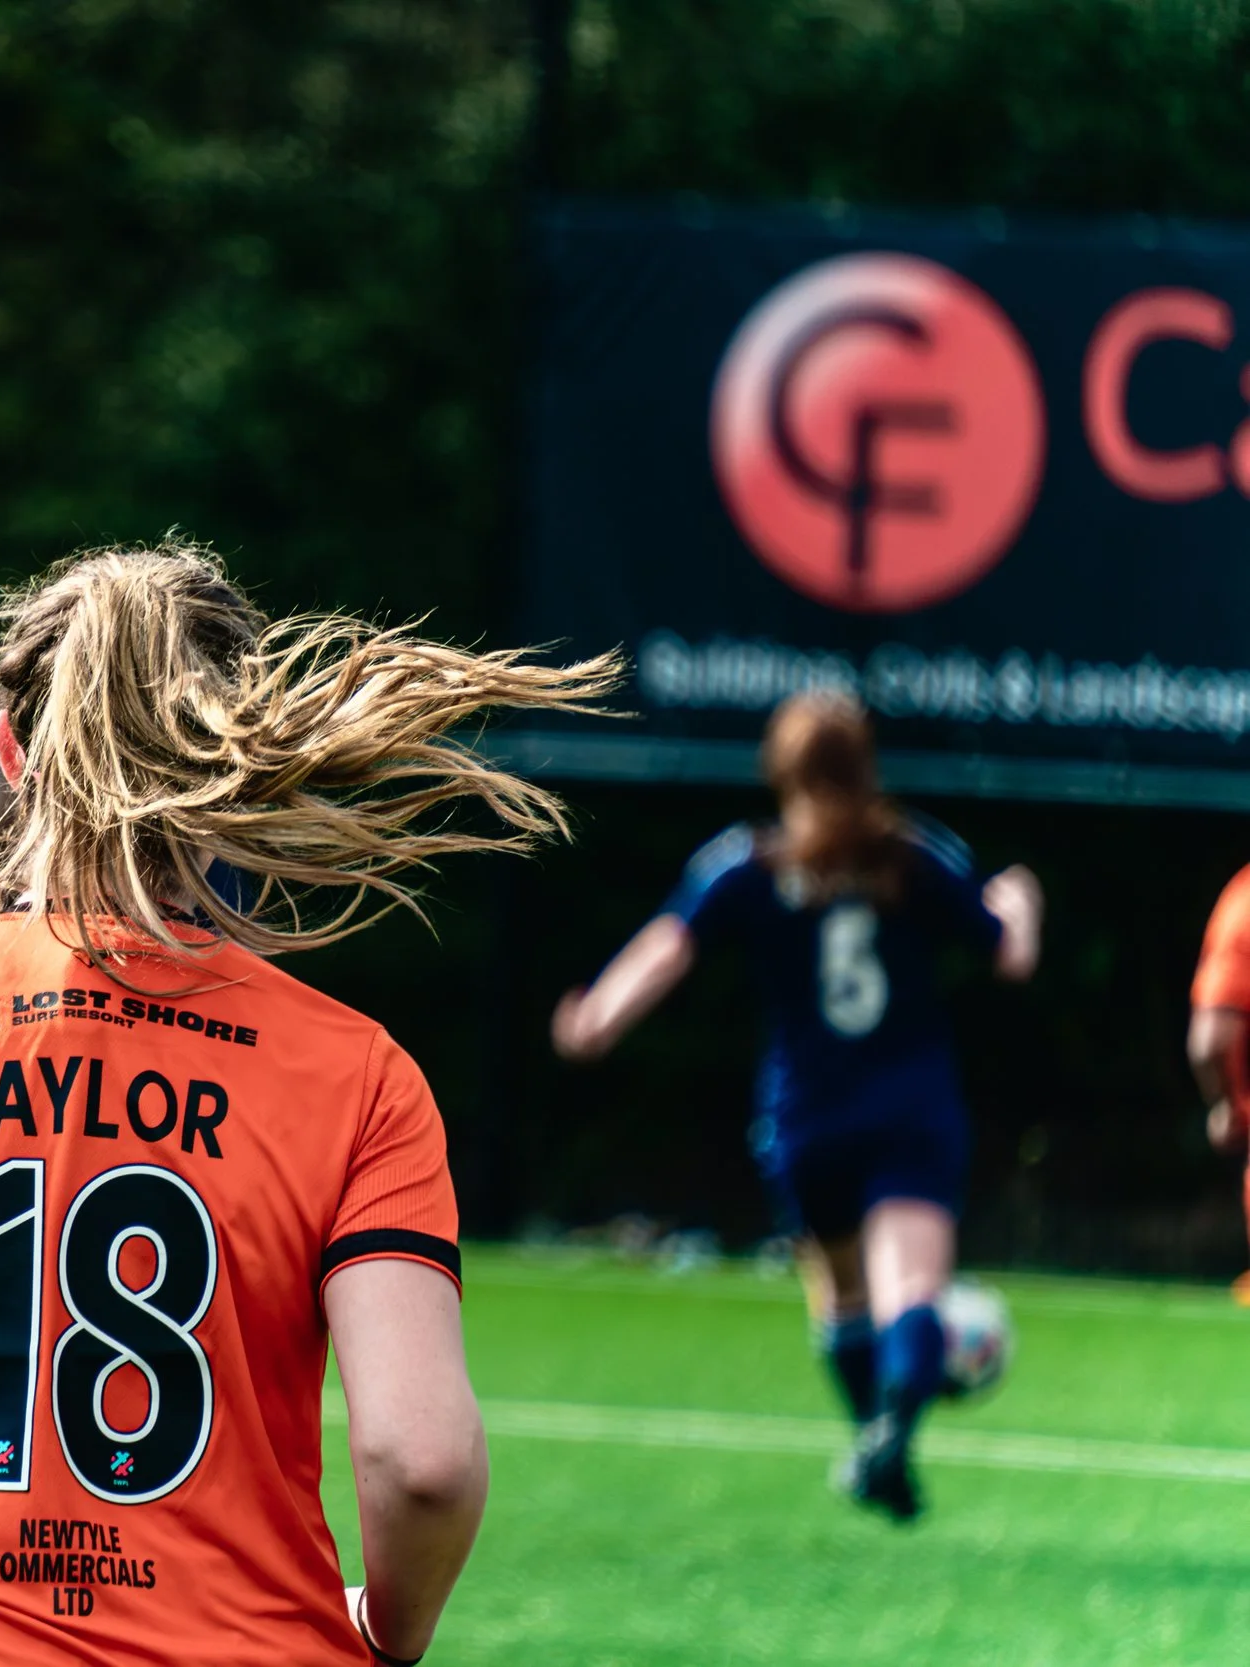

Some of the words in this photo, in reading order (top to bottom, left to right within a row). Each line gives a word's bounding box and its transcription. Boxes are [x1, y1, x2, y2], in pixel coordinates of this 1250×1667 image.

[1081, 286, 1250, 504] C
[12, 988, 111, 1013] LOST
[121, 997, 258, 1047] SHORE
[12, 1010, 58, 1026] SURF
[64, 1008, 136, 1029] RESORT
[19, 1519, 122, 1553] NEWTYLE
[53, 1587, 94, 1616] LTD
